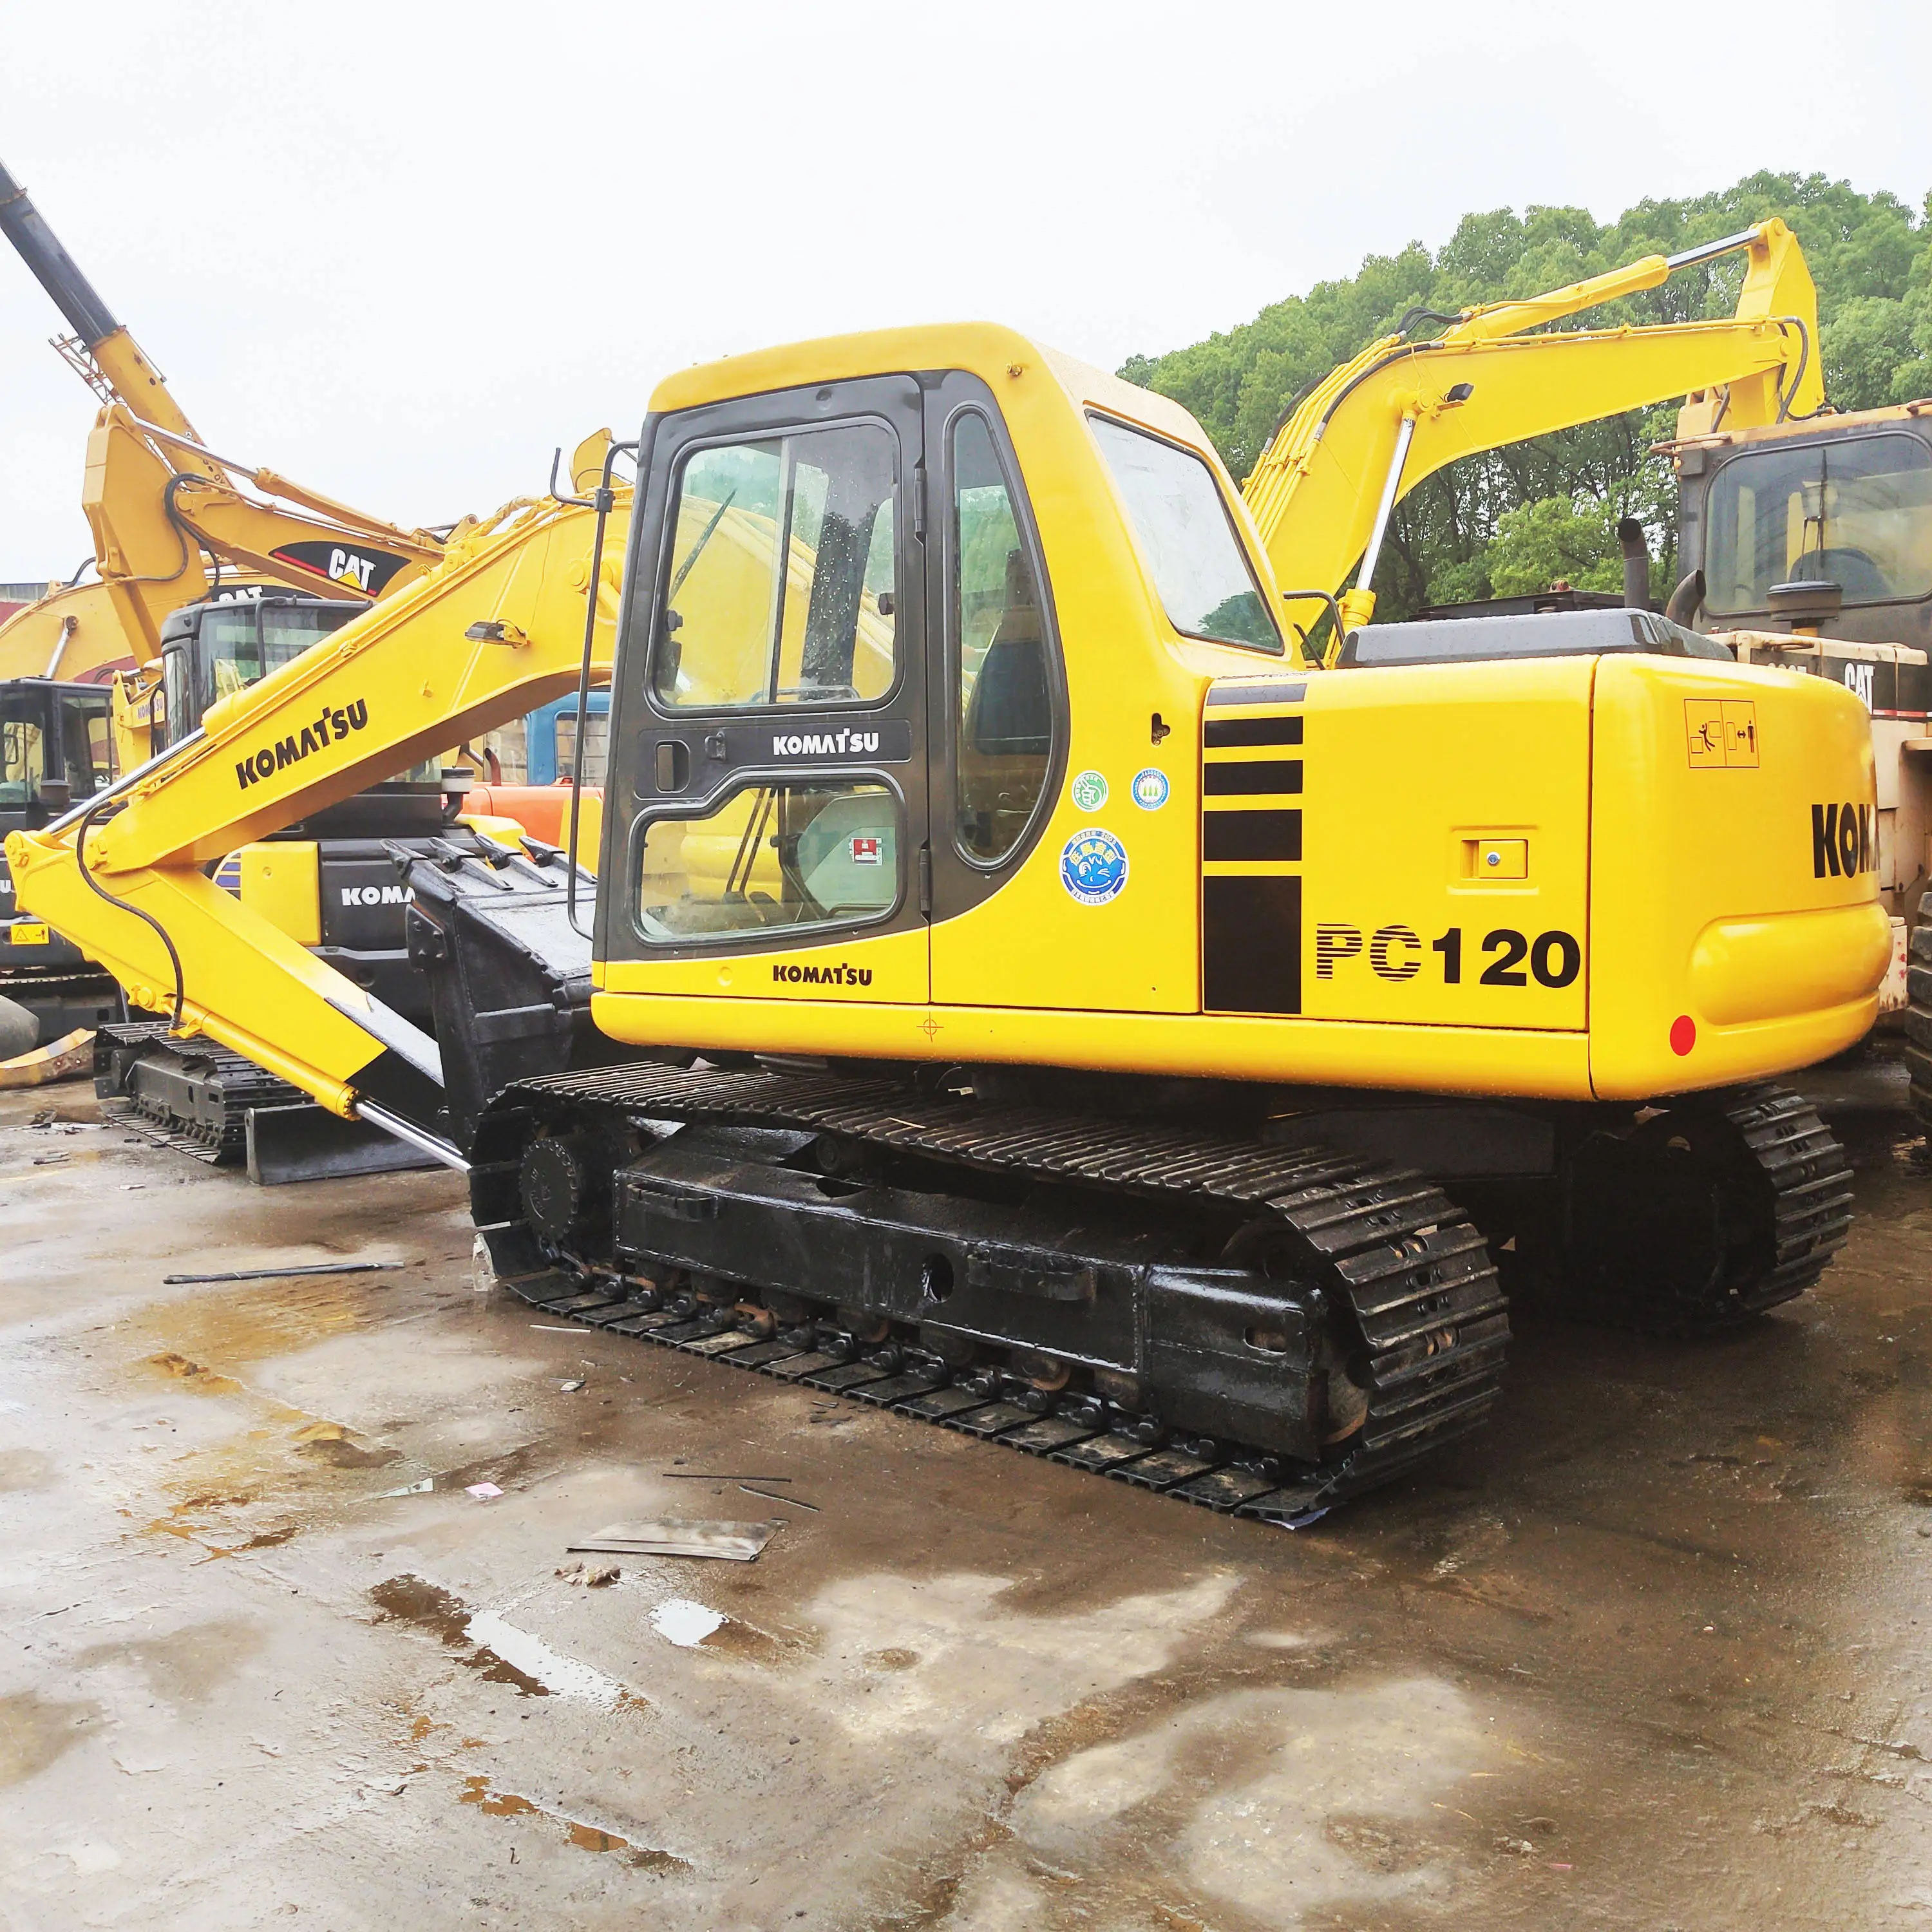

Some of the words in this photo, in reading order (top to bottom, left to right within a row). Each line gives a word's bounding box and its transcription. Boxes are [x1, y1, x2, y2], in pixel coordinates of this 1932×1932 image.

[328, 548, 376, 591] CAT
[235, 699, 368, 790] KOMATSU
[773, 728, 879, 755] KOMATSU
[341, 886, 416, 905] KOMA
[773, 963, 873, 986] KOMATSU
